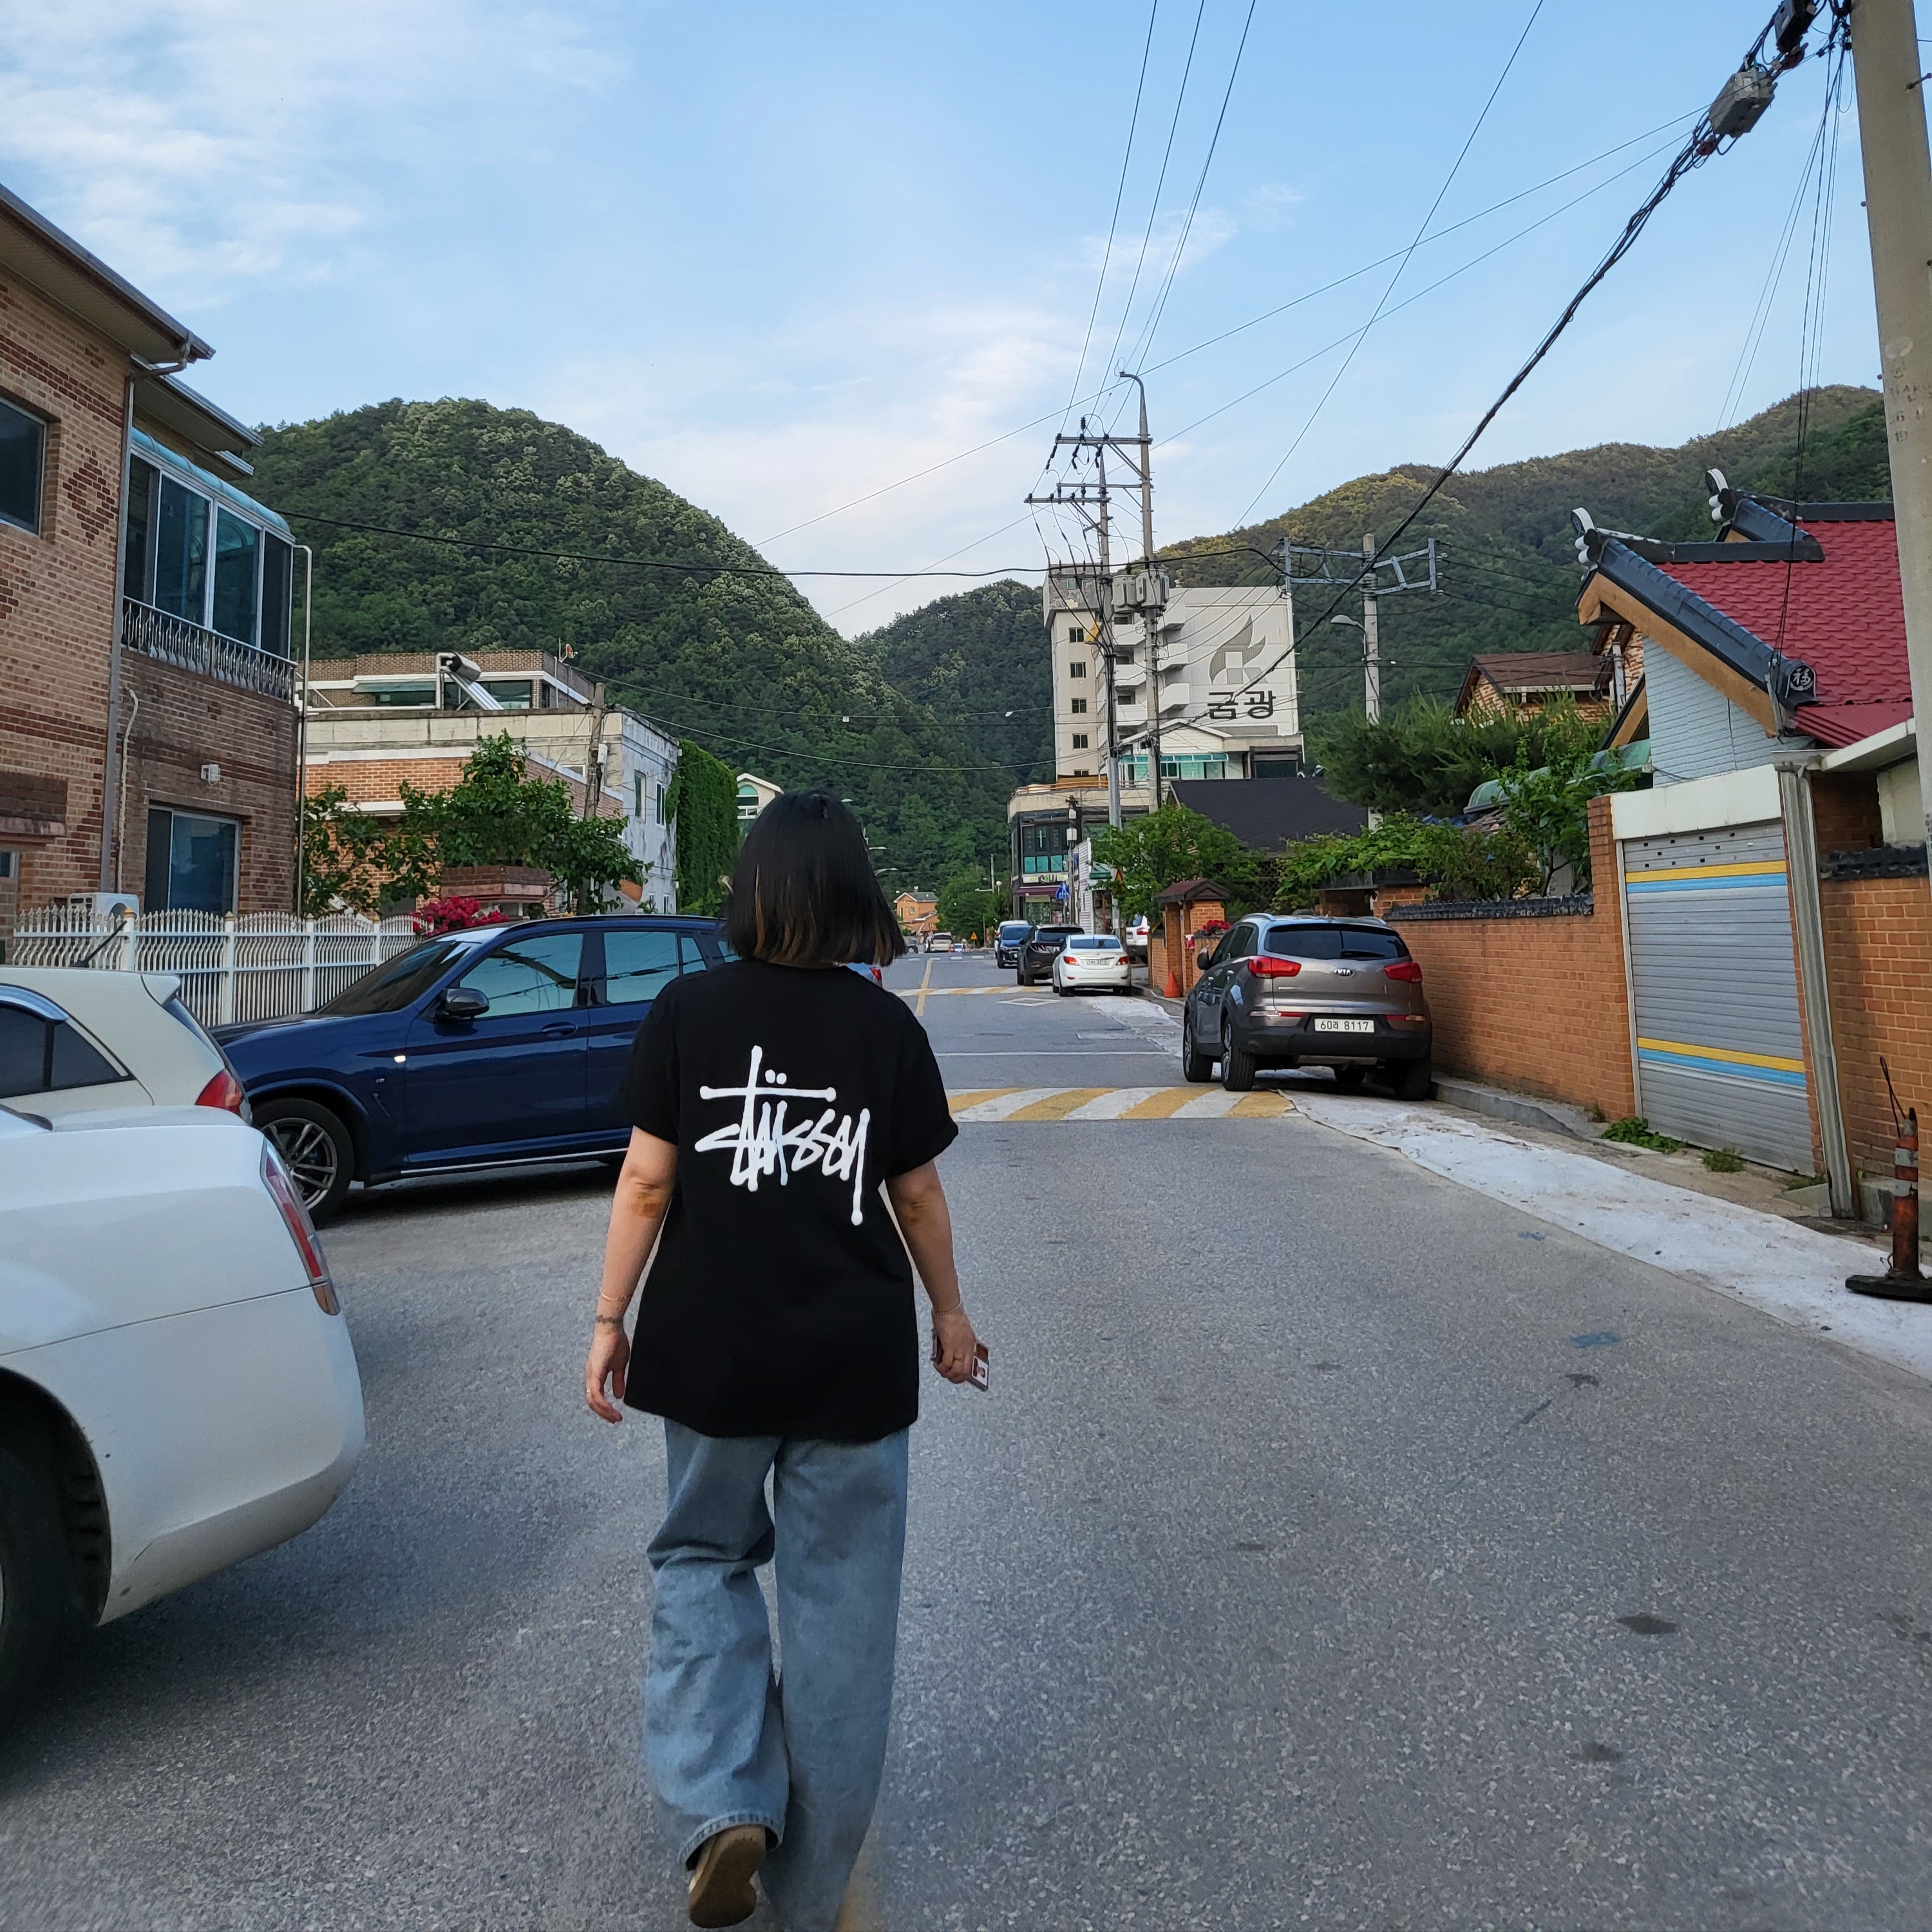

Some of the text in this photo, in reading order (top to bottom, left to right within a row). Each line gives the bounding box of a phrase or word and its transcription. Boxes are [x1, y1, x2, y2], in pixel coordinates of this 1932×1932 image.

[1792, 668, 1811, 686] 福
[1208, 690, 1276, 719] 금광
[1039, 874, 1056, 884] CU
[1336, 968, 1352, 976] KIA
[1343, 1021, 1368, 1031] 8117
